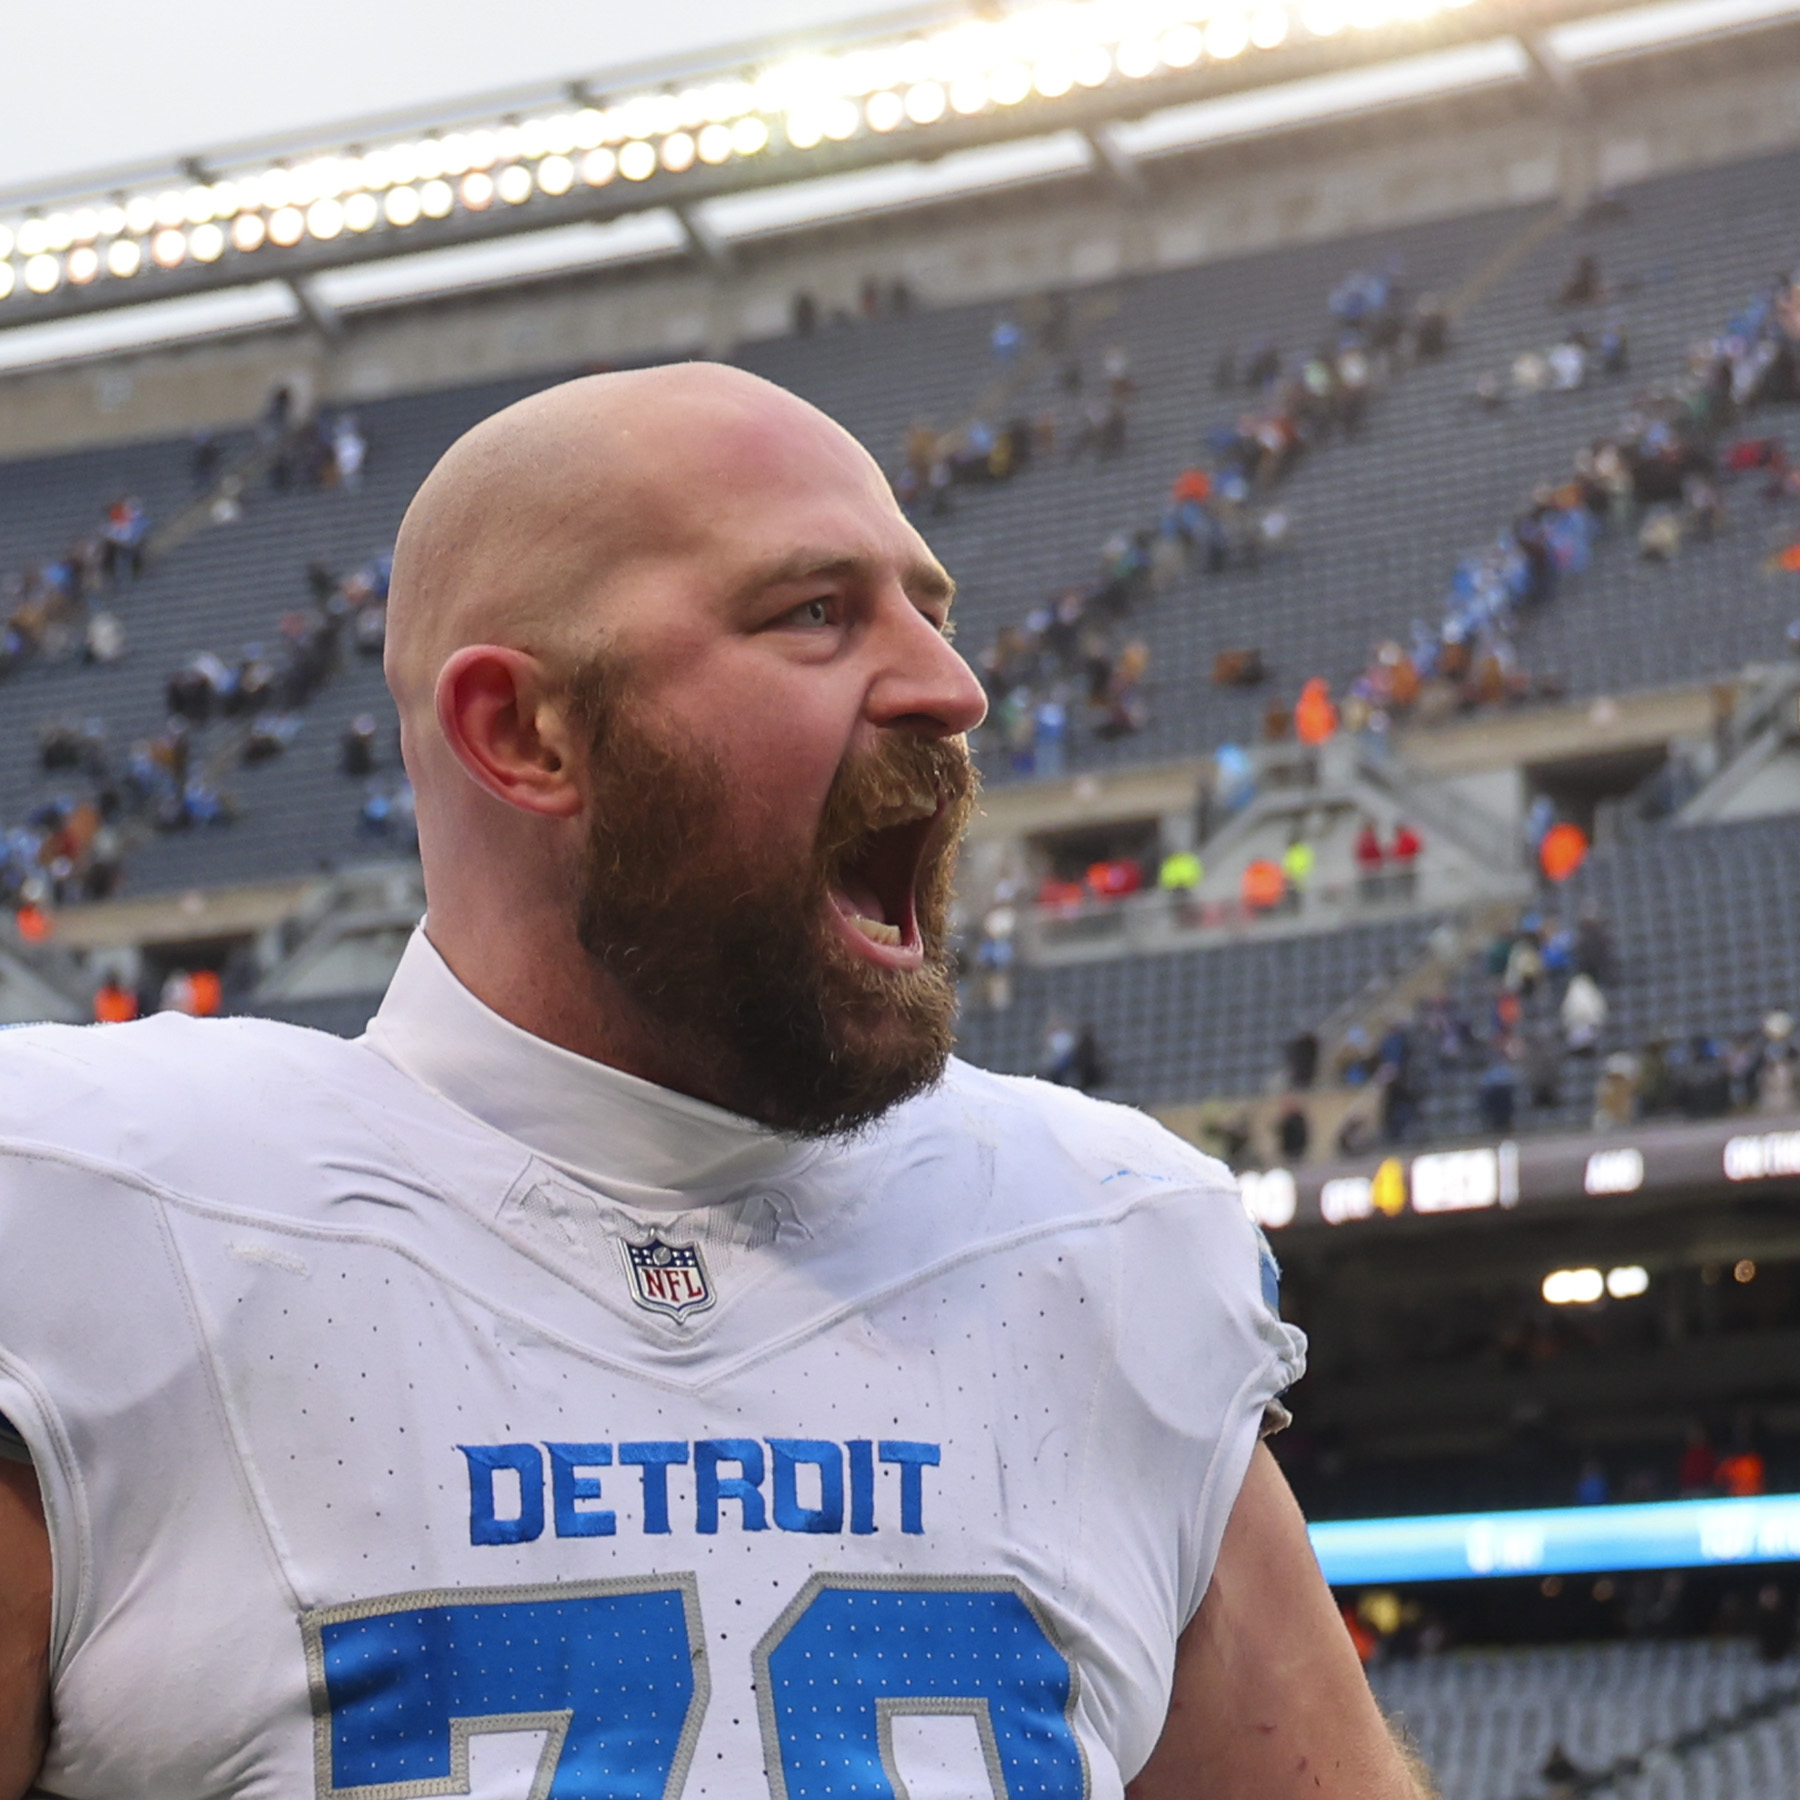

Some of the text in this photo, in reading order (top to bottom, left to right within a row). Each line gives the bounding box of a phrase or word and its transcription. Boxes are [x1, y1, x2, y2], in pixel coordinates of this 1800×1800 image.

[1373, 1156, 1405, 1217] 4
[642, 1267, 703, 1302] NFL
[457, 1438, 941, 1546] DETROIT
